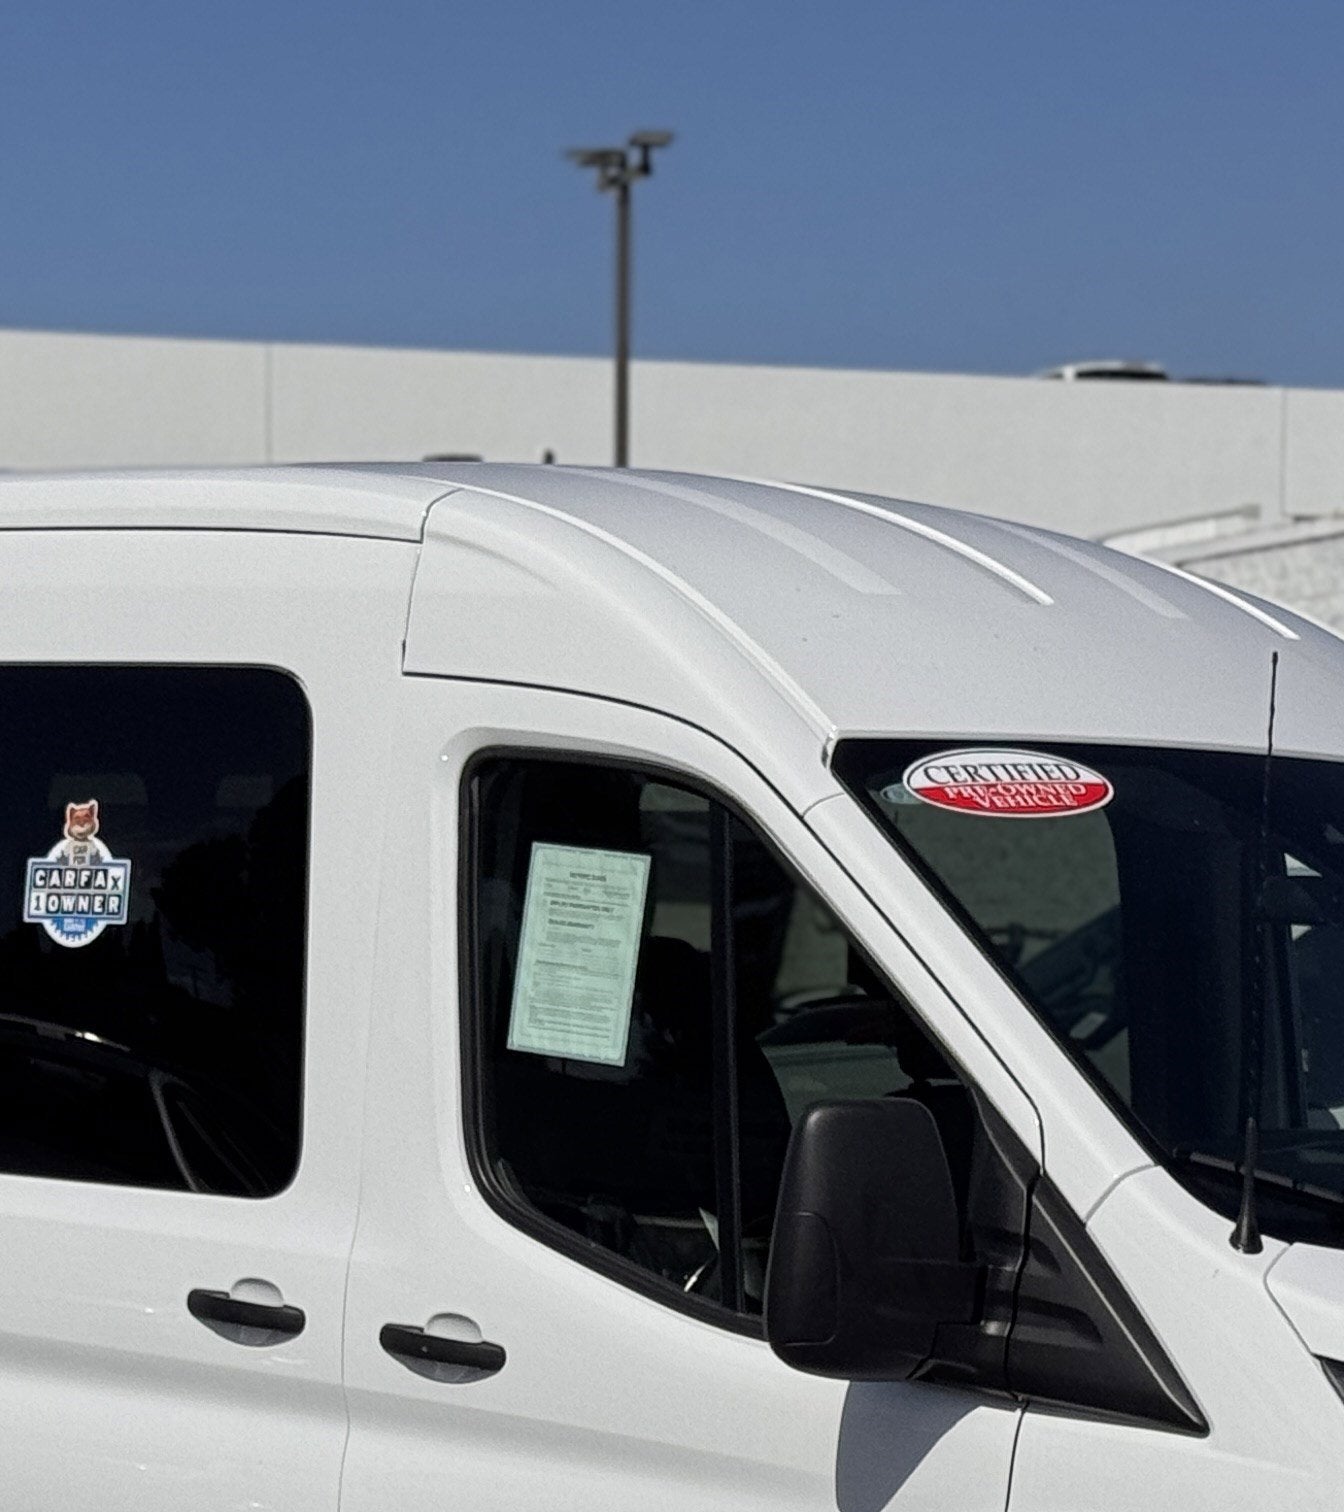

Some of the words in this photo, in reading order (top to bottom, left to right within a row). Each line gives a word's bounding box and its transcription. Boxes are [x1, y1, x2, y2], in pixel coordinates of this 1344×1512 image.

[923, 763, 1081, 785] CERTIFIED
[942, 783, 1087, 801] PRE-OWNED
[975, 794, 1079, 809] VEHICLE
[34, 869, 122, 891] CARFAX
